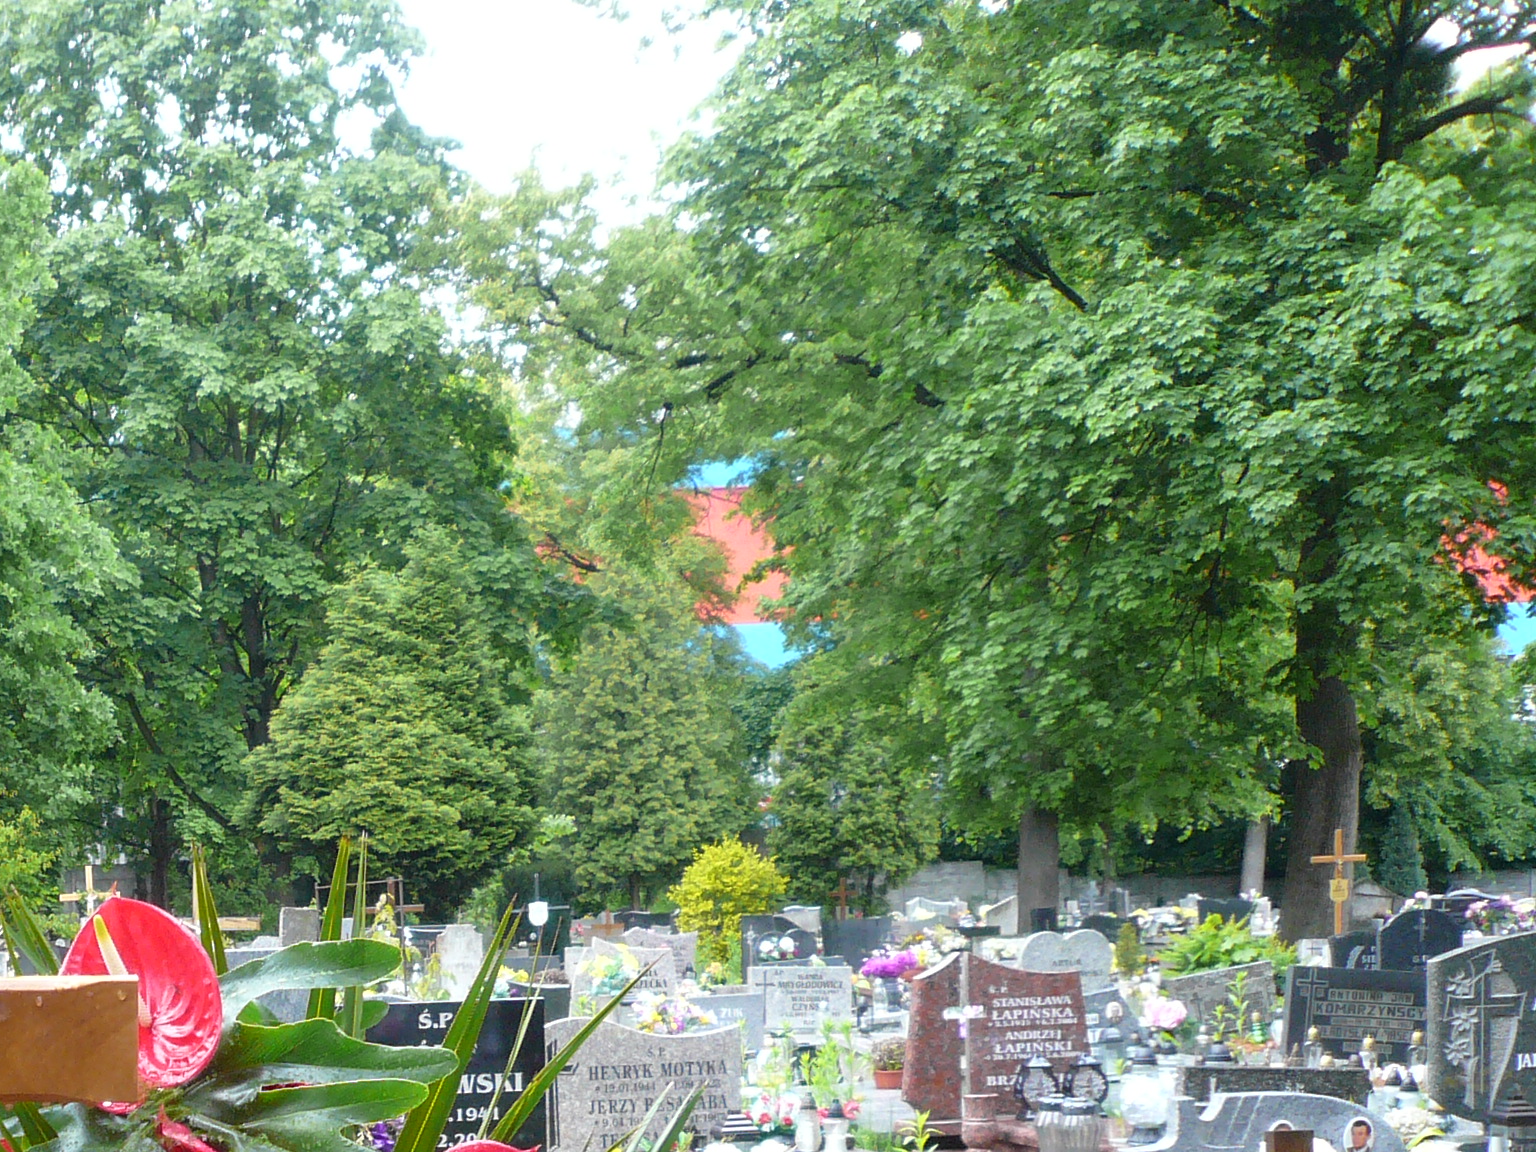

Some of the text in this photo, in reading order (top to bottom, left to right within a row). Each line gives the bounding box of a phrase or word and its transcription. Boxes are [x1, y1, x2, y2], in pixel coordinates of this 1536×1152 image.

[991, 995, 1072, 1008] STANISŁAWA
[991, 1006, 1075, 1021] ŁAPIŃSKA
[1005, 1029, 1062, 1041] ANDRZEJ
[994, 1040, 1073, 1054] ŁAPIŃSKI
[588, 1060, 728, 1081] HENRYK MOTYKA
[588, 1099, 637, 1116] JERZY
